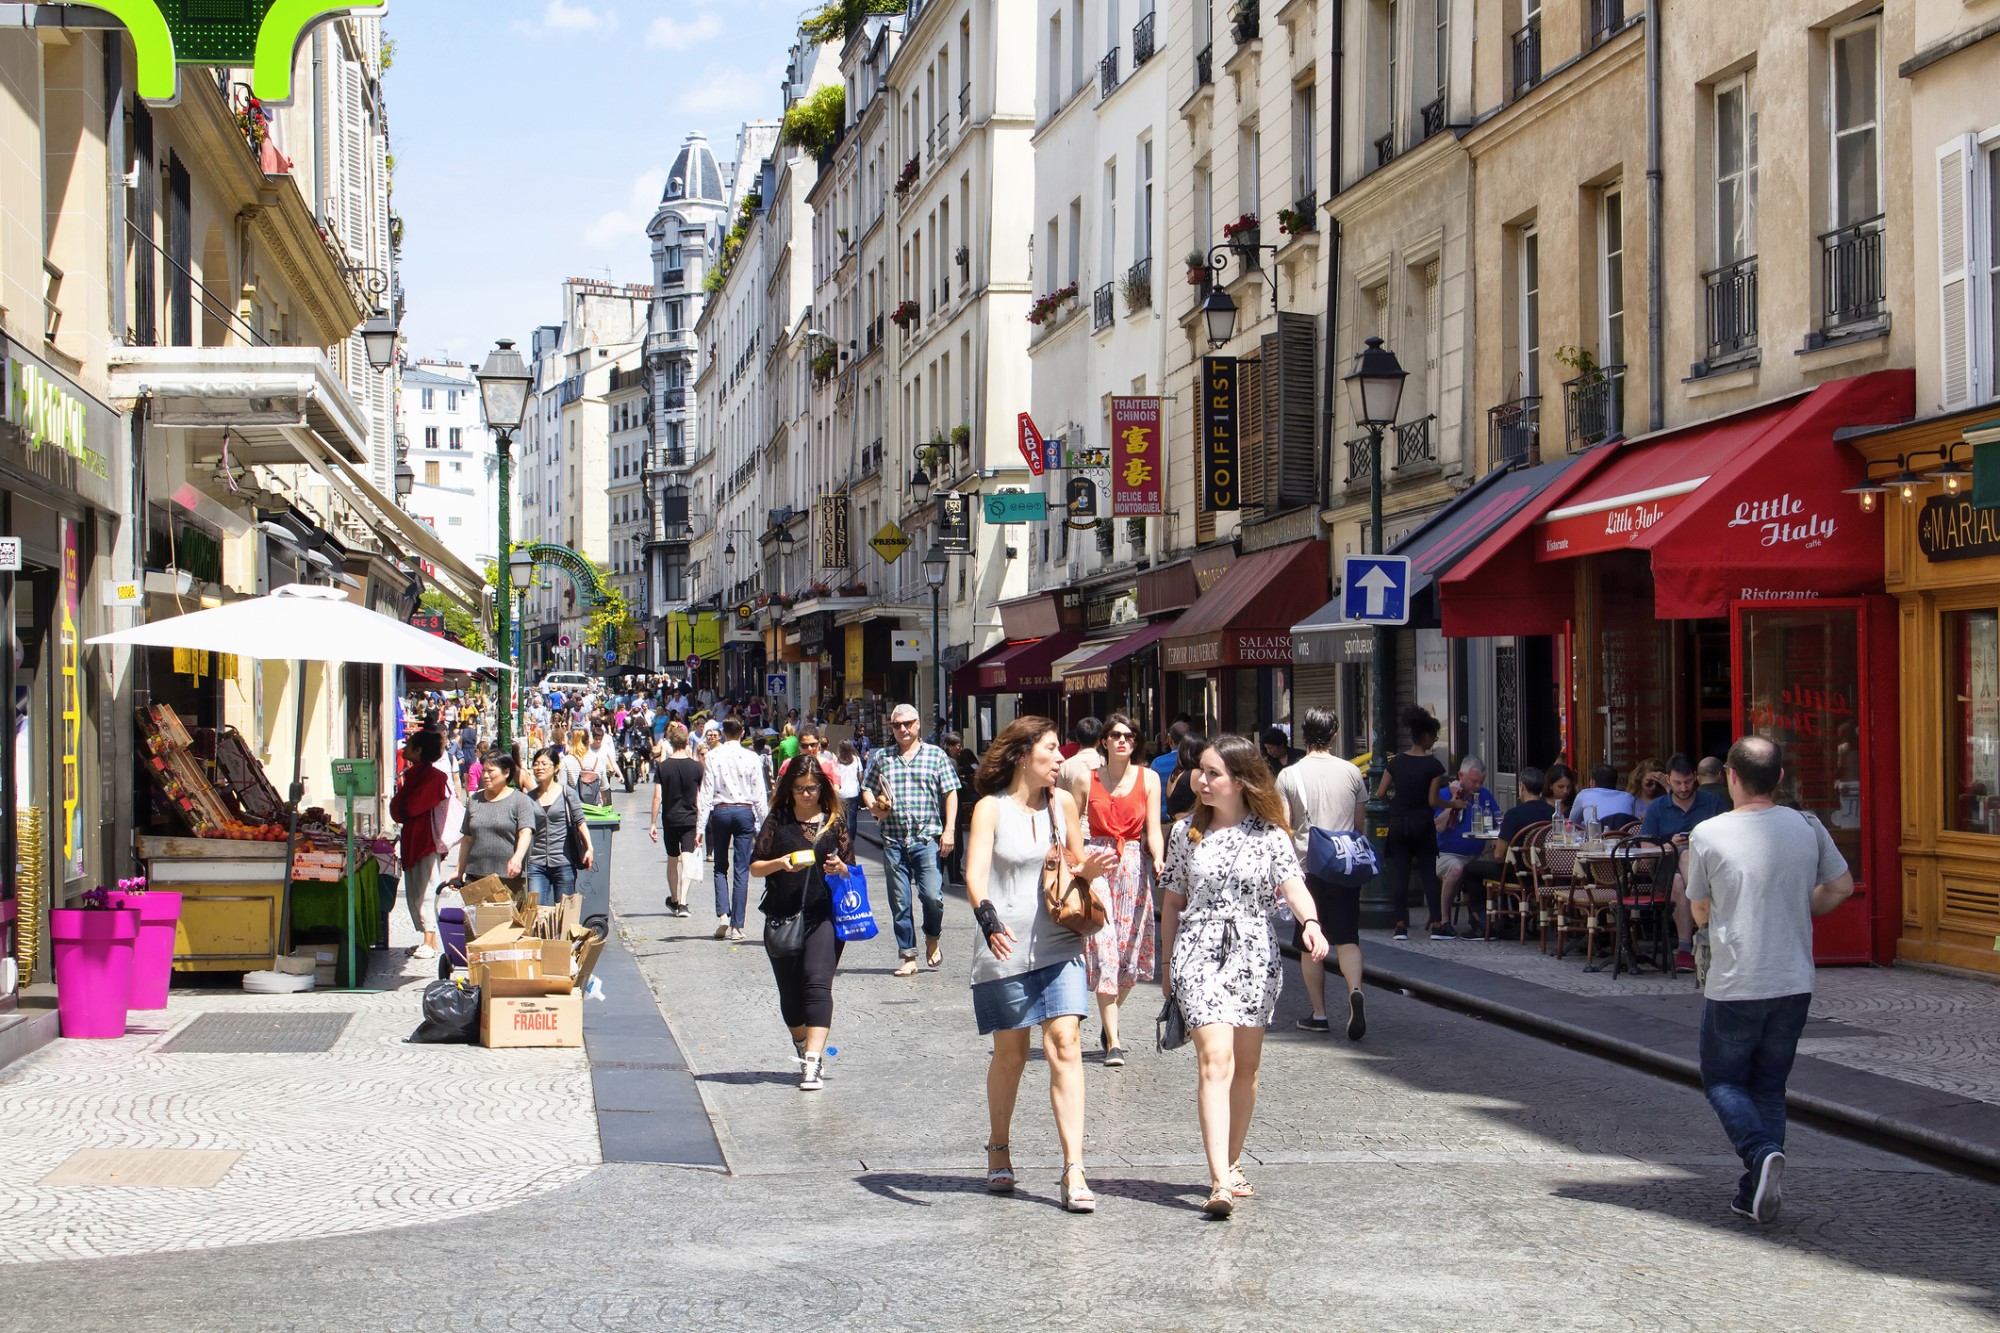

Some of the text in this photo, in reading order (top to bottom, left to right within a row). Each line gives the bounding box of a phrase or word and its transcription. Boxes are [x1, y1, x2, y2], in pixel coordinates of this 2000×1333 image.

[1113, 399, 1160, 410] TRAITEUR
[1116, 411, 1157, 421] CHINOIS
[1021, 418, 1041, 470] TABAC
[1213, 360, 1231, 506] COIFF1RST
[1121, 425, 1152, 487] 富豪
[1114, 502, 1161, 513] MONTORGUEIL
[1117, 491, 1158, 502] DELICE DE
[1604, 508, 1632, 536] Little
[1727, 493, 1805, 528] Little
[823, 497, 834, 567] BOULANGER
[836, 497, 846, 567] PATISSIER
[1760, 513, 1839, 547] Italy
[873, 538, 908, 546] PRESSE
[1546, 538, 1569, 552] Ristorante
[1741, 588, 1819, 600] Ristorante
[513, 1013, 558, 1031] FRAGILE
